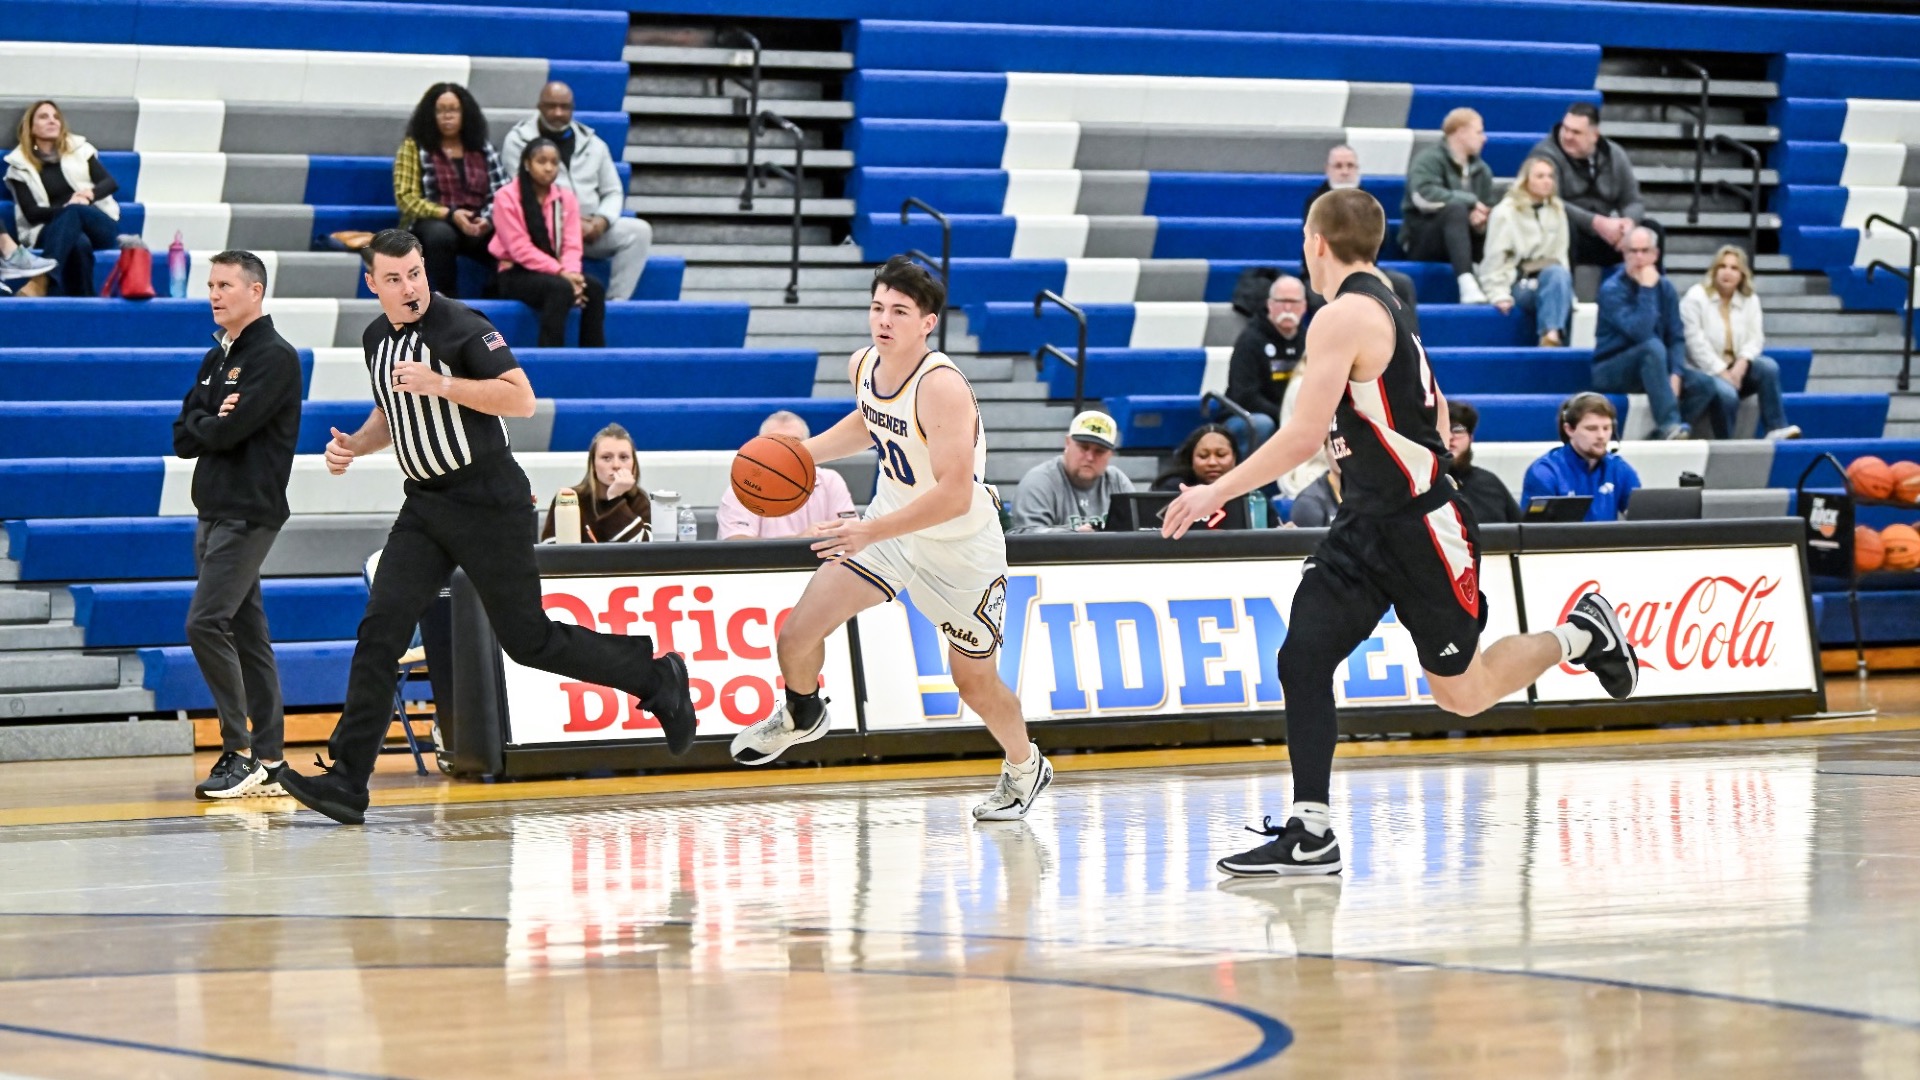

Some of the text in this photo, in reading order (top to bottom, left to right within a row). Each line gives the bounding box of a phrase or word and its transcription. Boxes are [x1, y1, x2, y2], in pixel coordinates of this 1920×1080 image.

[861, 400, 908, 437] WIDENER
[869, 430, 916, 486] 20
[541, 585, 796, 661] ffic
[894, 574, 1436, 720] WIDEE
[940, 621, 979, 647] Pride
[1556, 575, 1782, 675] Cca-Cola
